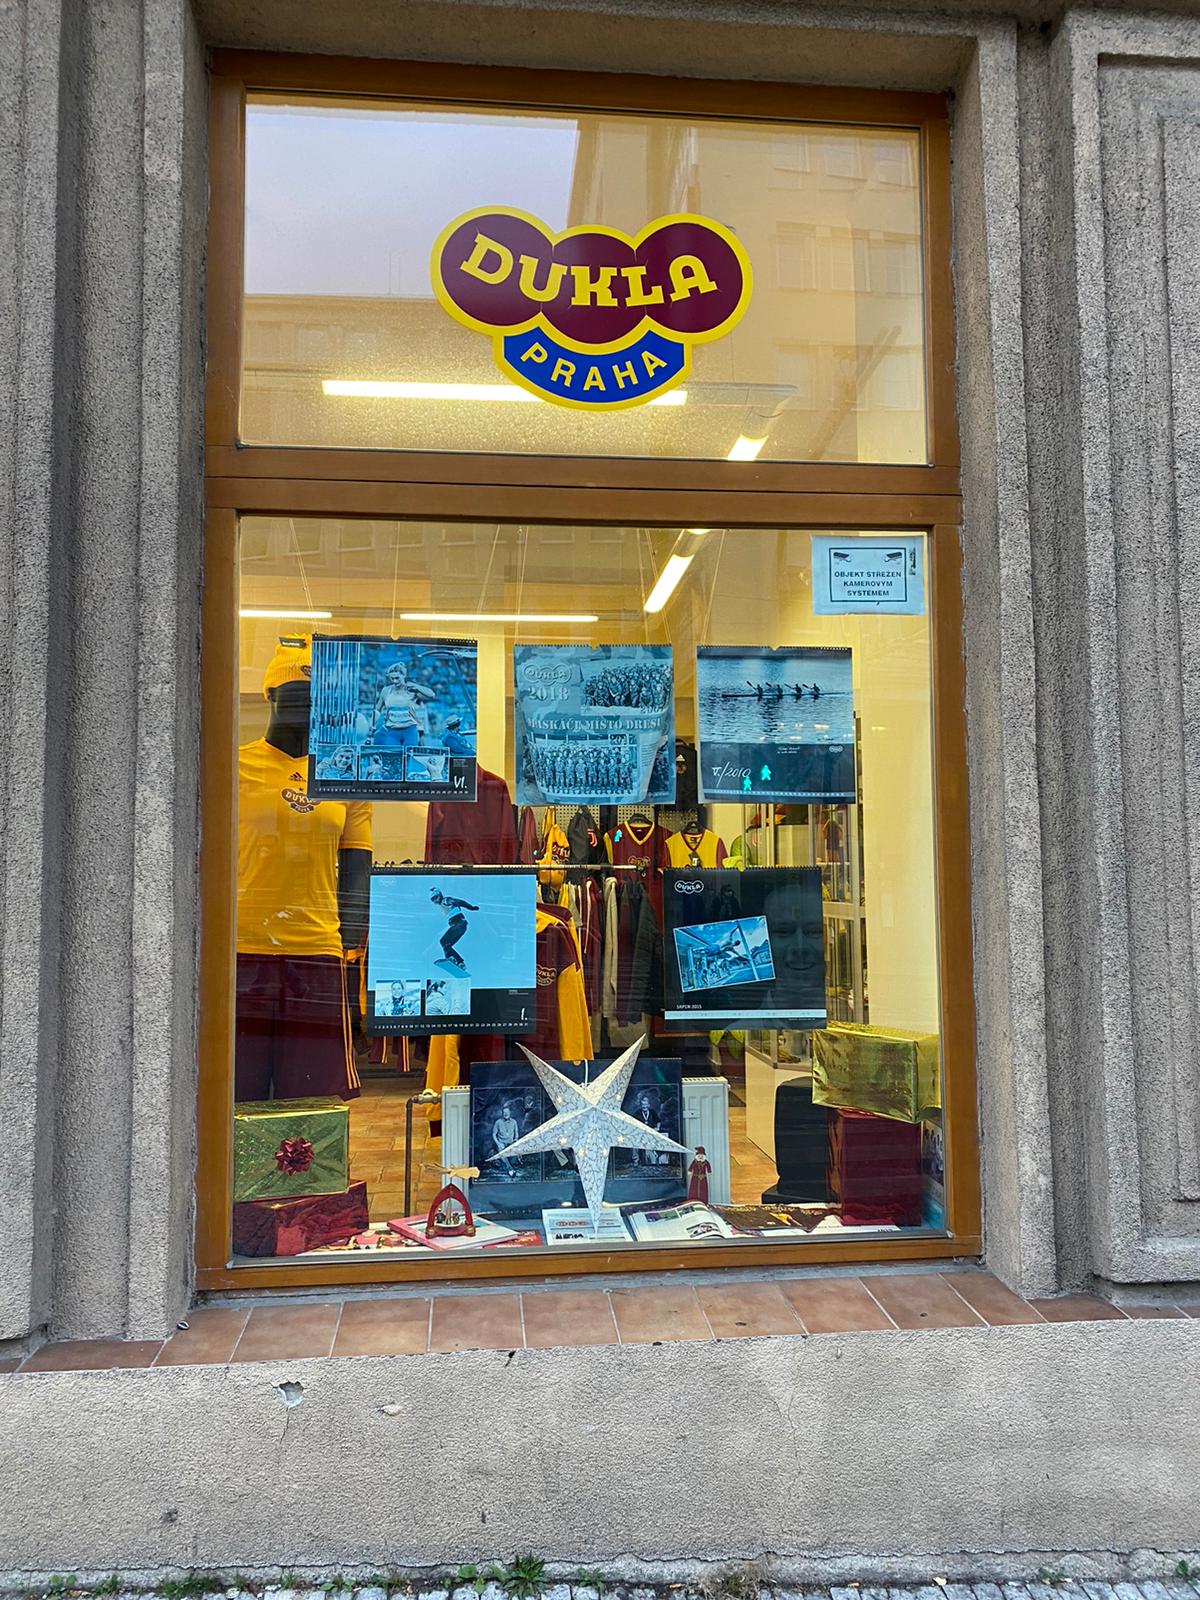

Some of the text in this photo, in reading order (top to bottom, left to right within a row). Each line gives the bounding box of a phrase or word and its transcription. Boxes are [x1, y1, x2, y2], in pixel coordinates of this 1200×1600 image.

[460, 232, 718, 307] DUKLA
[520, 341, 668, 392] PRAHA
[528, 687, 569, 701] 2018
